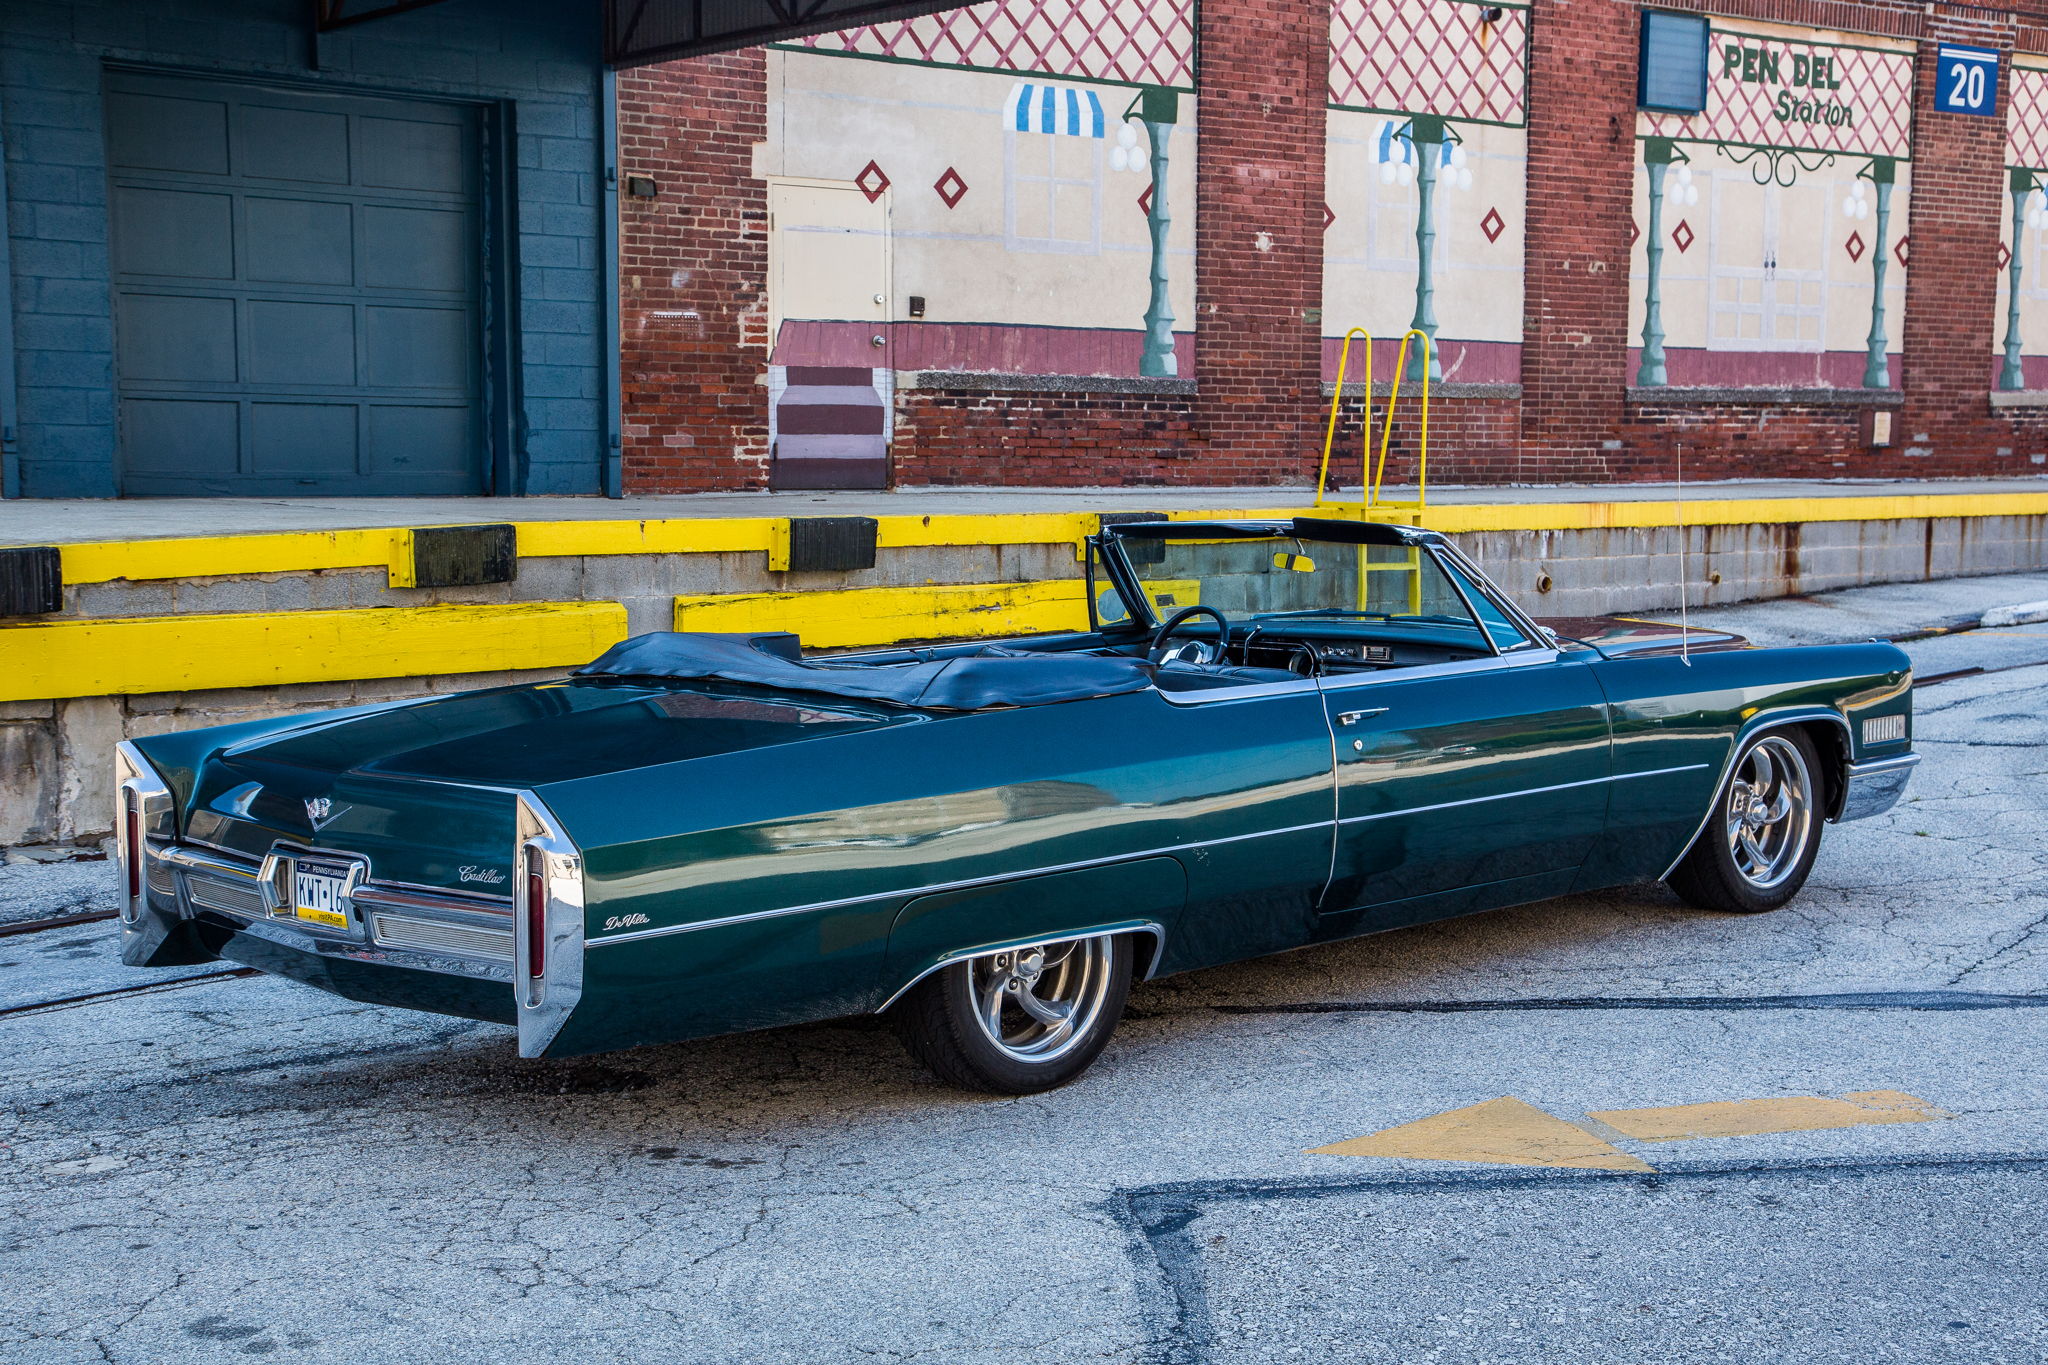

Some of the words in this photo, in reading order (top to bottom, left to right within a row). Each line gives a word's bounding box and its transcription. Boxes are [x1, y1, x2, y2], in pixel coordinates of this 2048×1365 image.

[1723, 44, 1779, 85] PEN
[1793, 54, 1841, 90] DEL
[1949, 63, 1985, 108] 20
[1773, 90, 1853, 128] Station
[312, 865, 346, 877] PENNSYLVANIA
[459, 866, 506, 883] Cadillac
